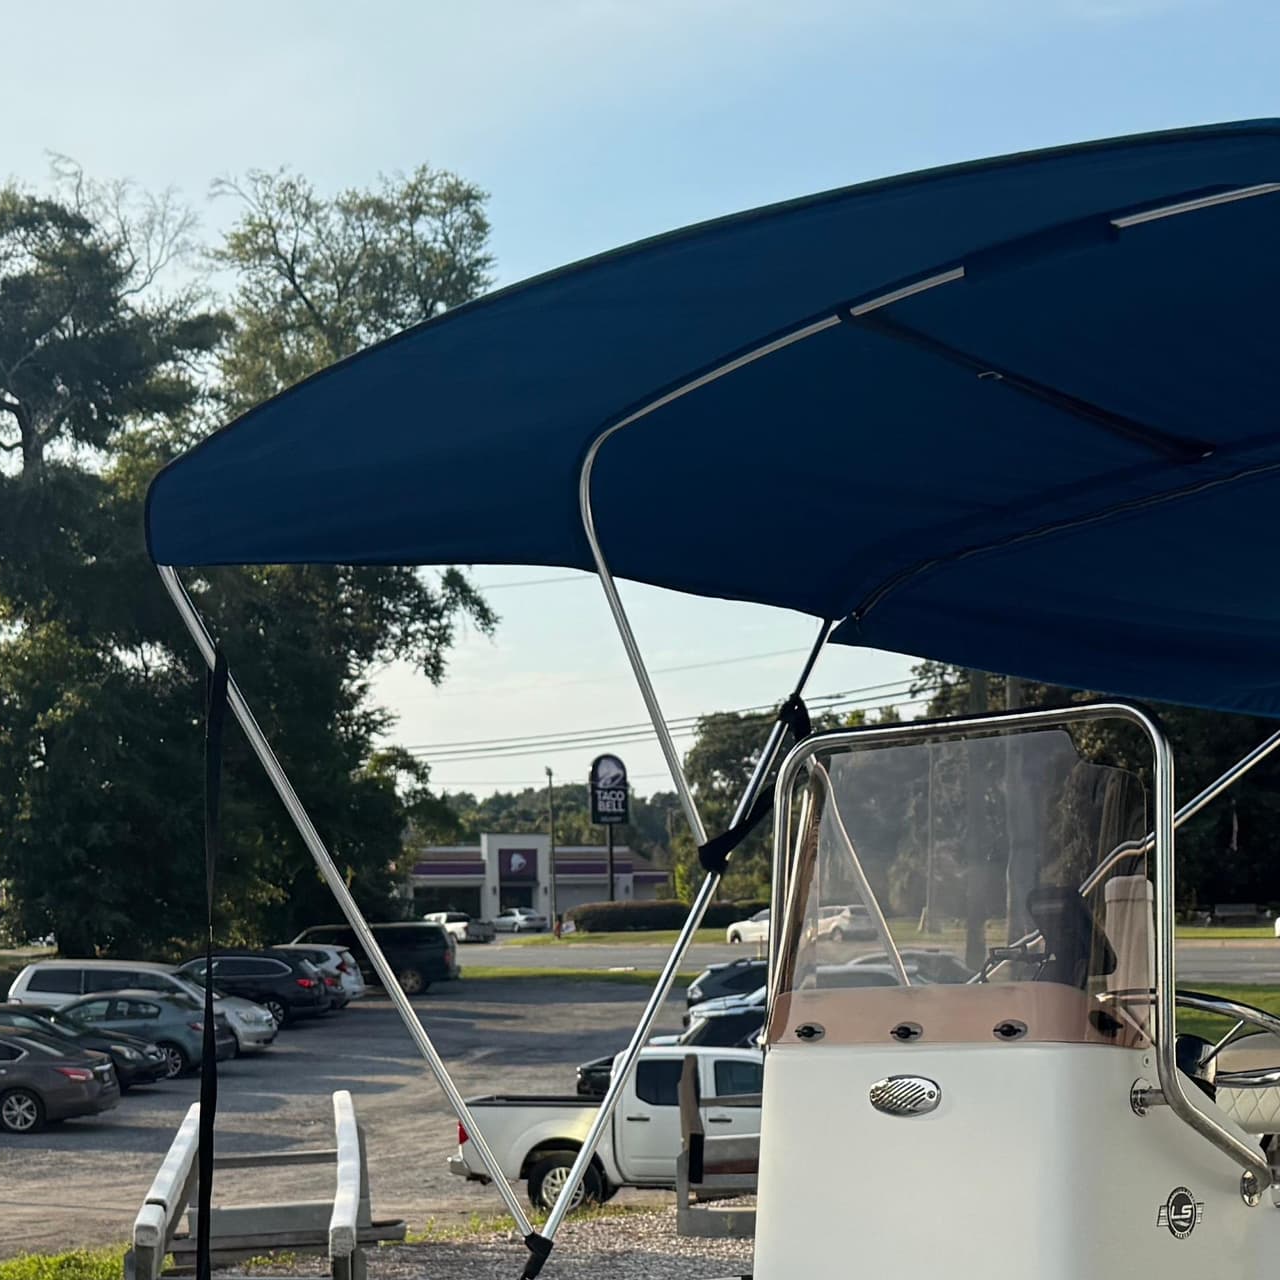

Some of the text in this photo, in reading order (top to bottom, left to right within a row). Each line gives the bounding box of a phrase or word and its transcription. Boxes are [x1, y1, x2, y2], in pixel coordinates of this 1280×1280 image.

[595, 790, 625, 801] TACO
[597, 801, 625, 812] BELL
[1171, 1204, 1193, 1219] LS
